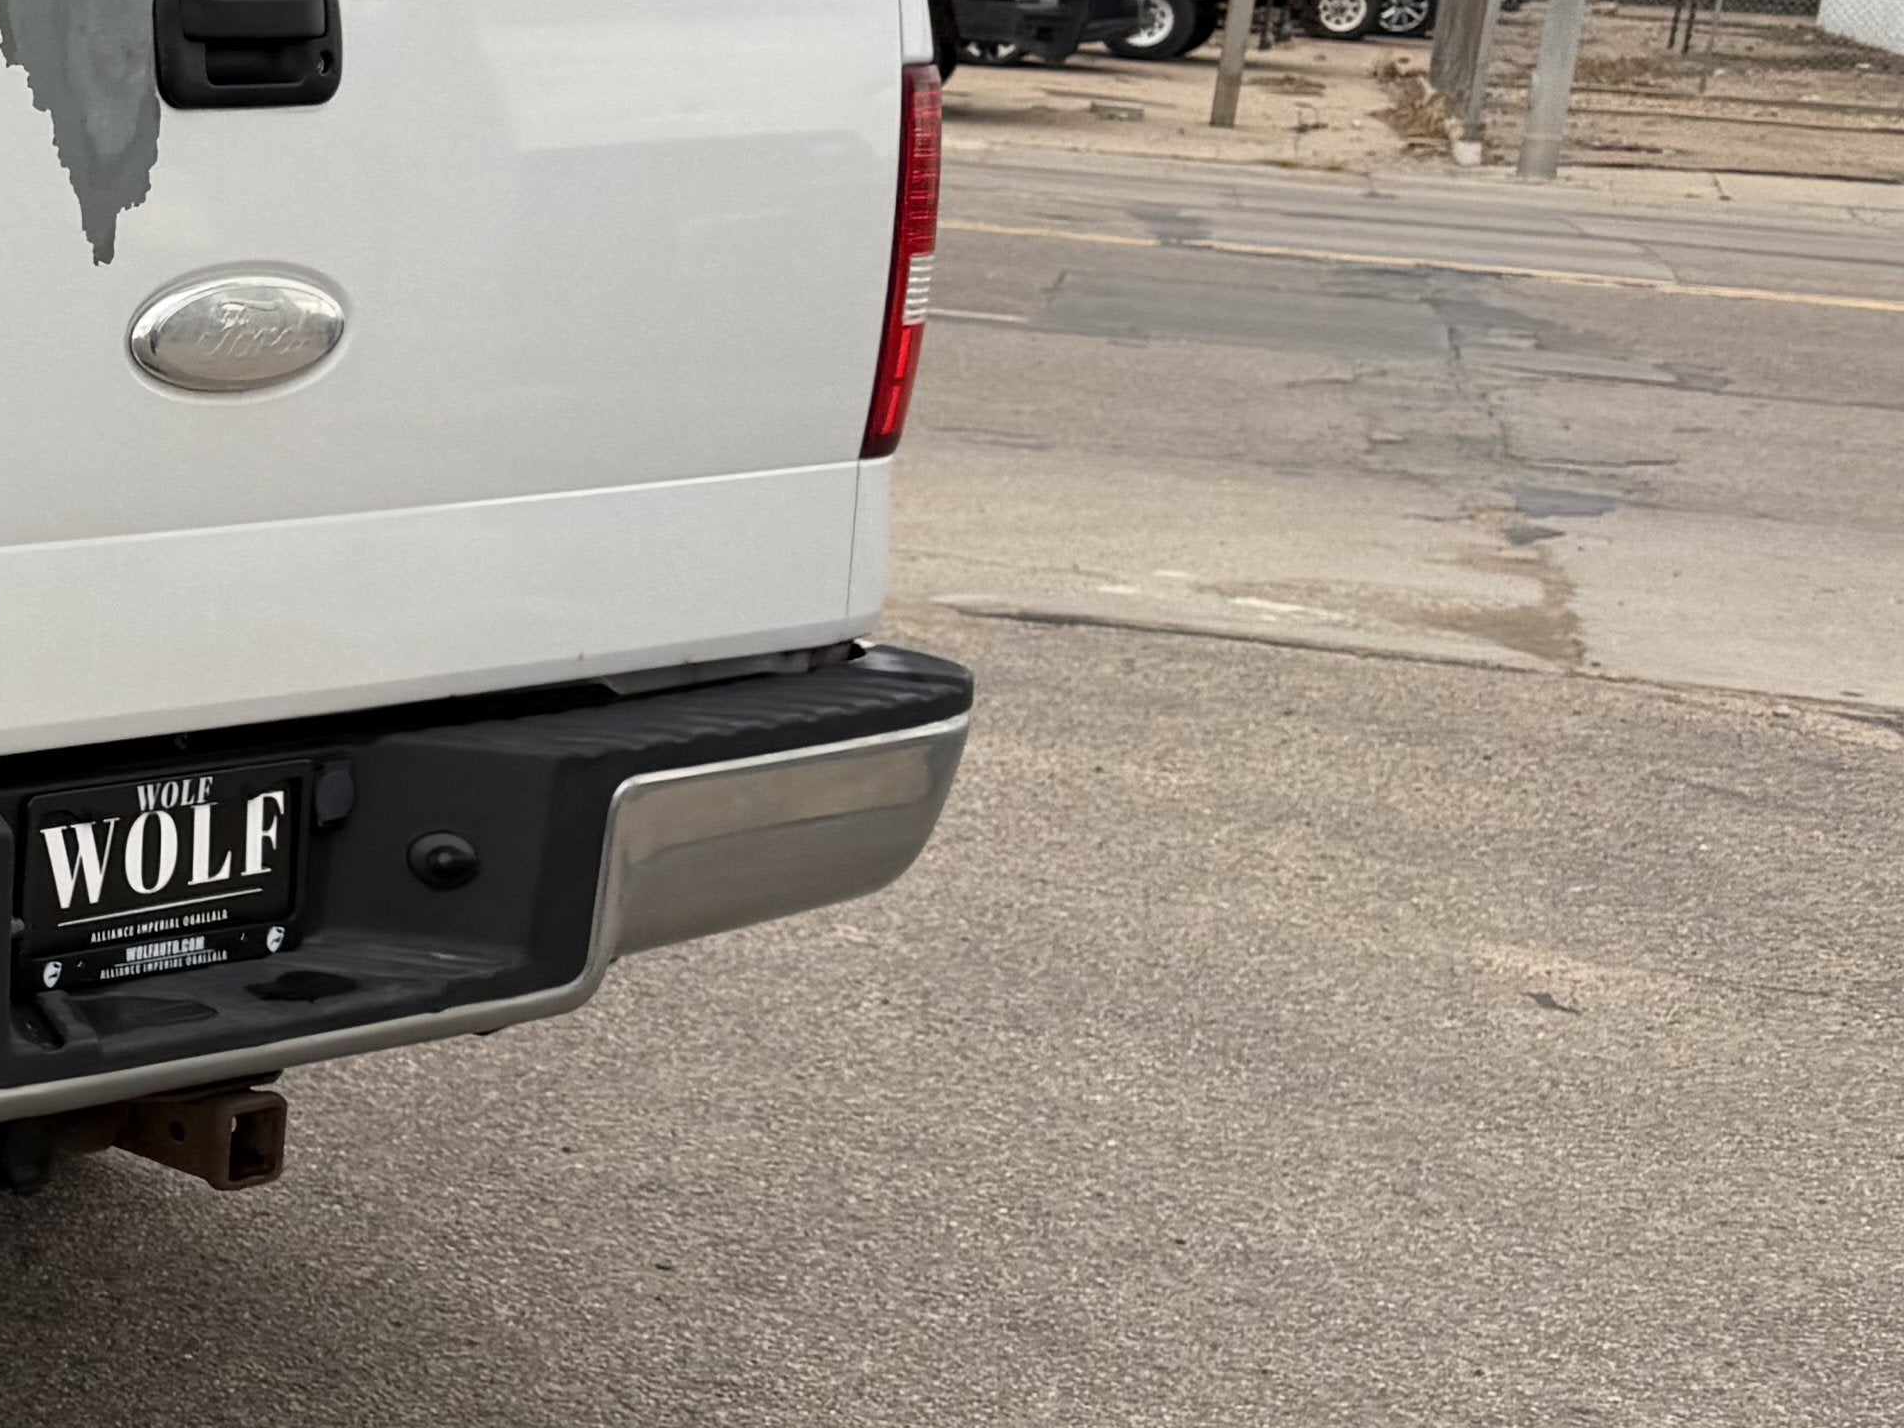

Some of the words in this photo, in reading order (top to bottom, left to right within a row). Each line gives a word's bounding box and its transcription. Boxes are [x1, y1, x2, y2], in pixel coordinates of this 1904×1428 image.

[137, 776, 213, 812] WOLF
[39, 790, 285, 909] WOLF
[91, 925, 134, 943] ALLIANCE
[136, 917, 180, 935] IMPERIAL
[126, 935, 205, 962] WOLFAUTO.COM
